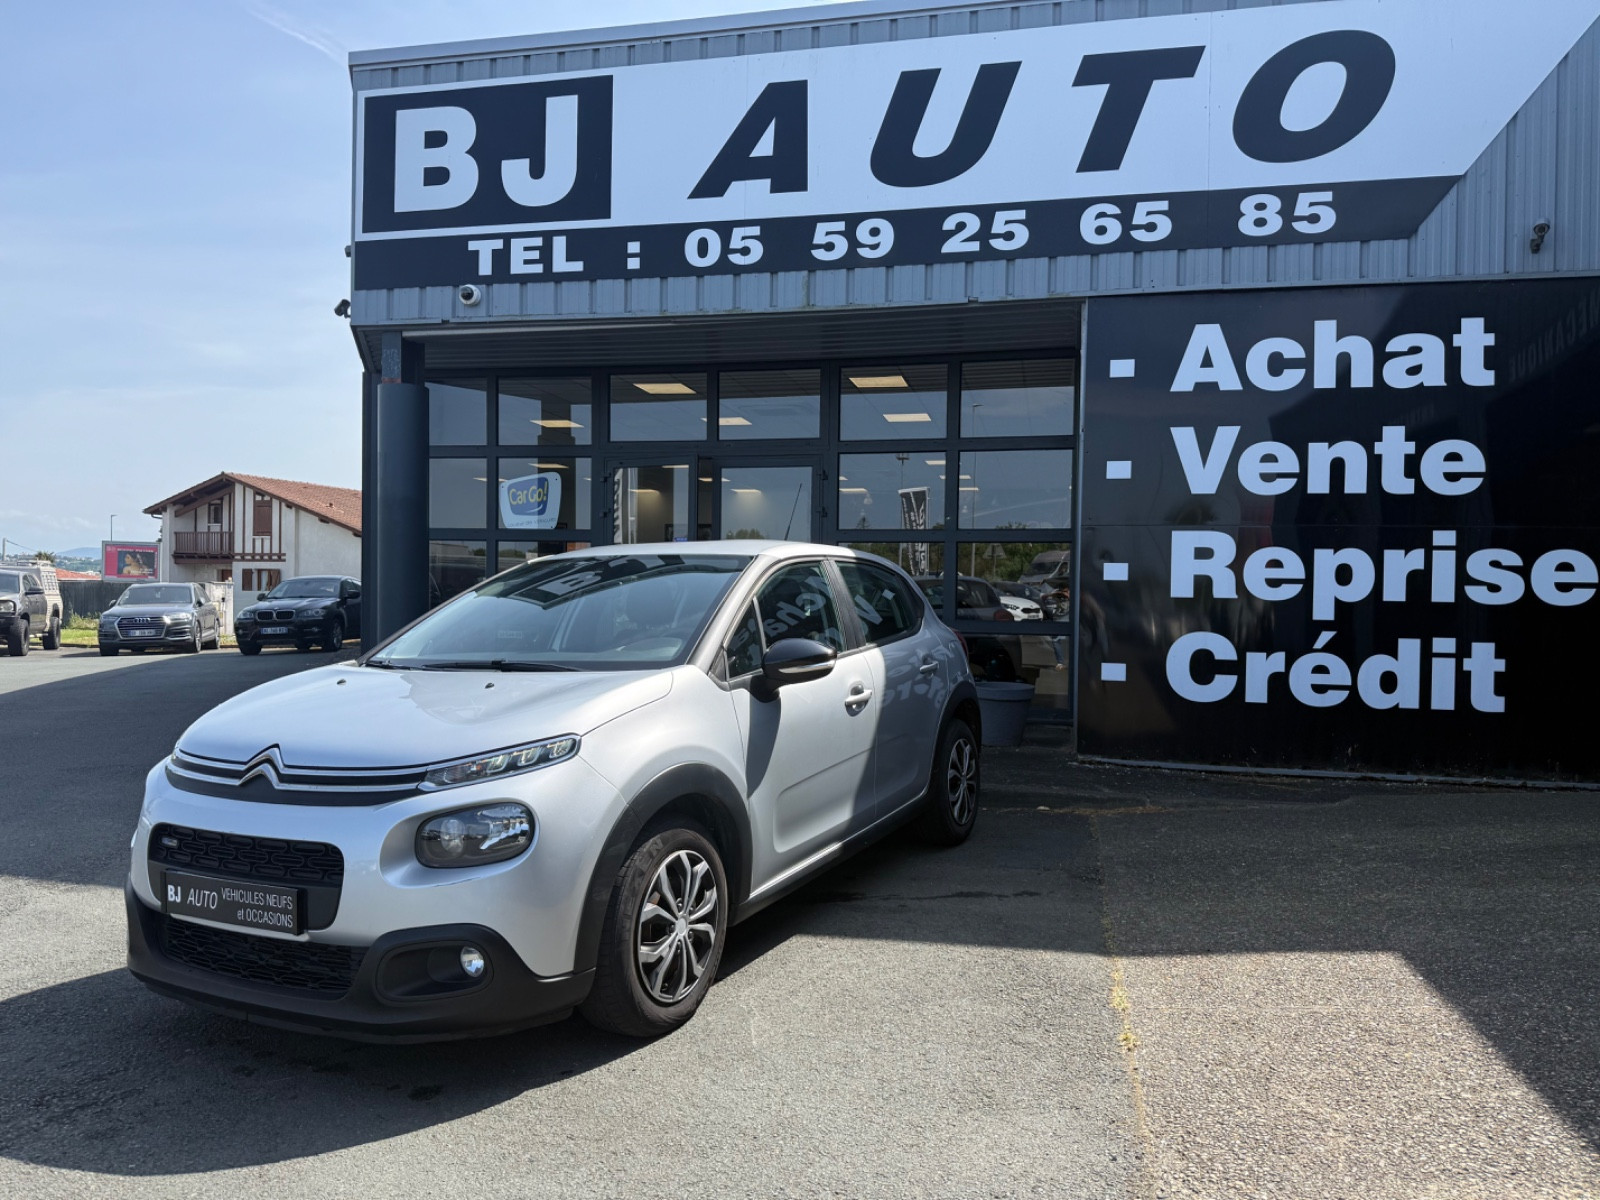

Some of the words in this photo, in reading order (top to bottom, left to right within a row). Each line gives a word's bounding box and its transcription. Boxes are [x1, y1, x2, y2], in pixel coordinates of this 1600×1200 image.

[394, 94, 579, 213] BJ
[688, 29, 1396, 200] AUTO
[467, 236, 584, 276] TEL
[684, 225, 764, 268] 05
[810, 218, 895, 261] 59
[940, 209, 1030, 254] 25
[1079, 200, 1173, 245] 65
[1237, 191, 1337, 237] 85
[1170, 317, 1495, 392] Achat
[1170, 425, 1486, 496] Vente
[1170, 530, 1599, 621] Reprise
[1165, 630, 1506, 713] Crédit
[167, 885, 181, 903] BJ
[187, 888, 218, 909] AUTO
[221, 888, 264, 905] VEHICULES
[266, 894, 293, 909] NEUFS
[237, 909, 244, 920] et
[246, 909, 293, 928] OCCASIONS
